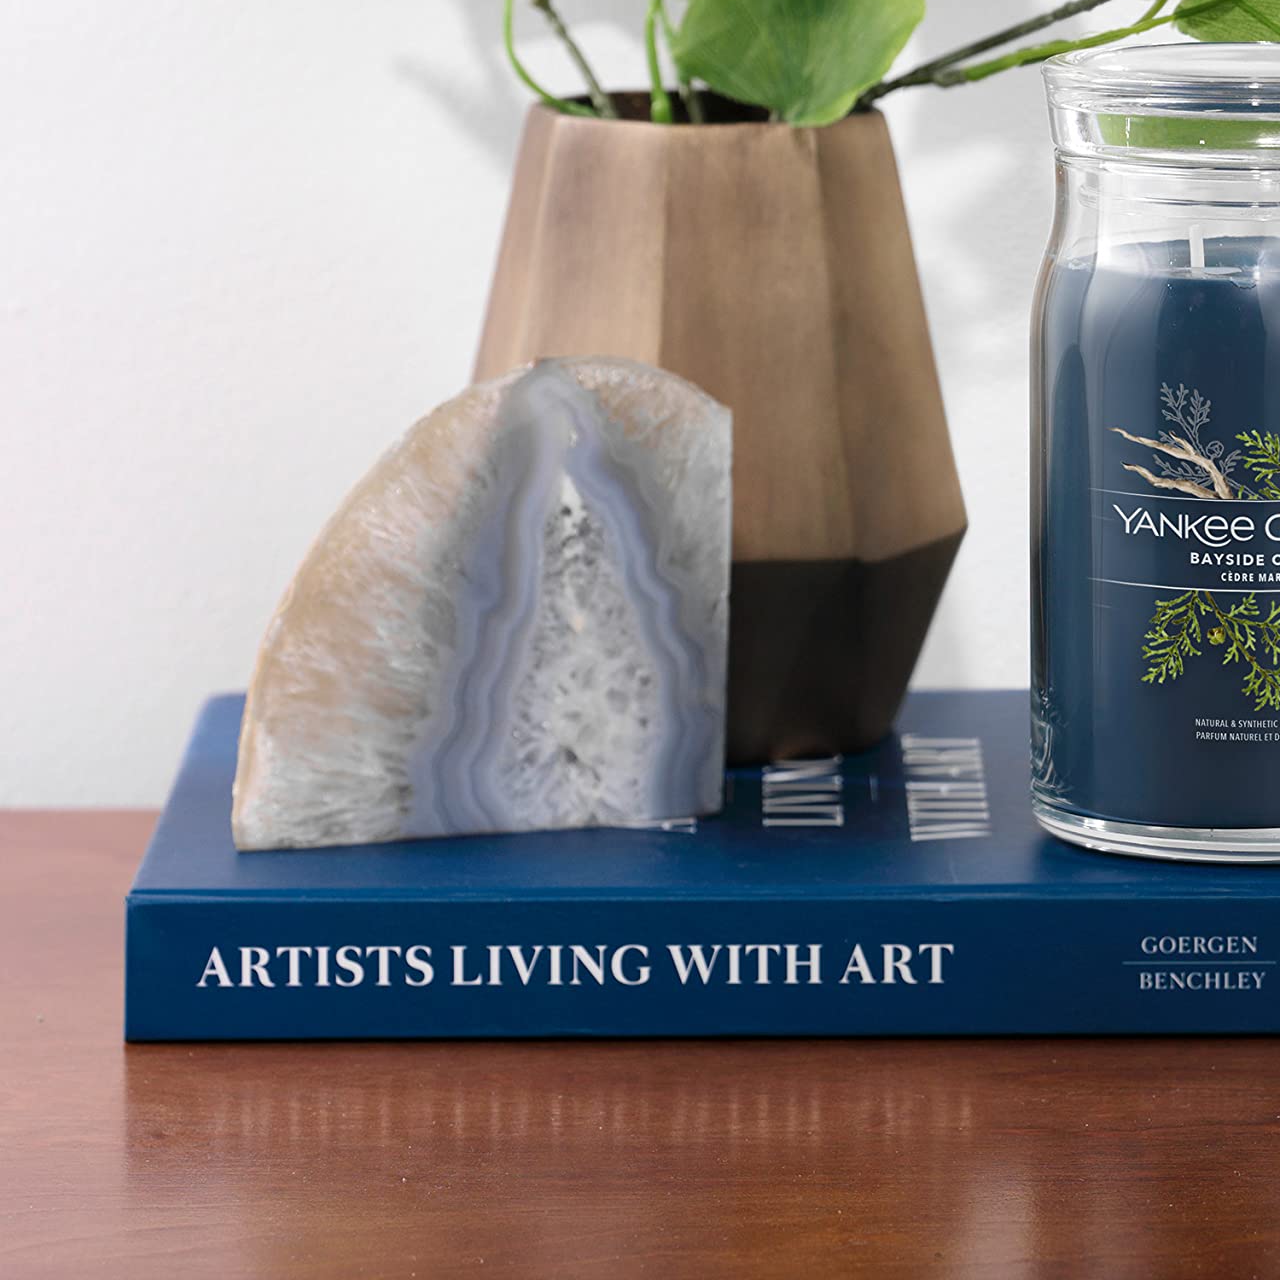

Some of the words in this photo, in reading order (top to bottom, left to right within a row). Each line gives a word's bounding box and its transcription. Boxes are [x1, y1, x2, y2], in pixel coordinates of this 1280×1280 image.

[1190, 551, 1265, 567] BAYSIDE
[1220, 570, 1254, 583] CÈDRE
[1195, 718, 1229, 728] NATURAL
[1230, 719, 1237, 728] &
[1238, 720, 1278, 728] SYNTHETIC
[1196, 731, 1227, 741] PARFUM
[1229, 732, 1262, 742] NATUREL
[1264, 733, 1272, 741] ET
[762, 754, 843, 826] LIVIN
[1140, 935, 1258, 955] GOERGEN
[195, 945, 435, 988] ARTISTS
[450, 944, 651, 986] LIVING
[666, 944, 823, 985] WITH
[838, 943, 954, 984] ART
[1139, 971, 1266, 991] BENCHLEY
